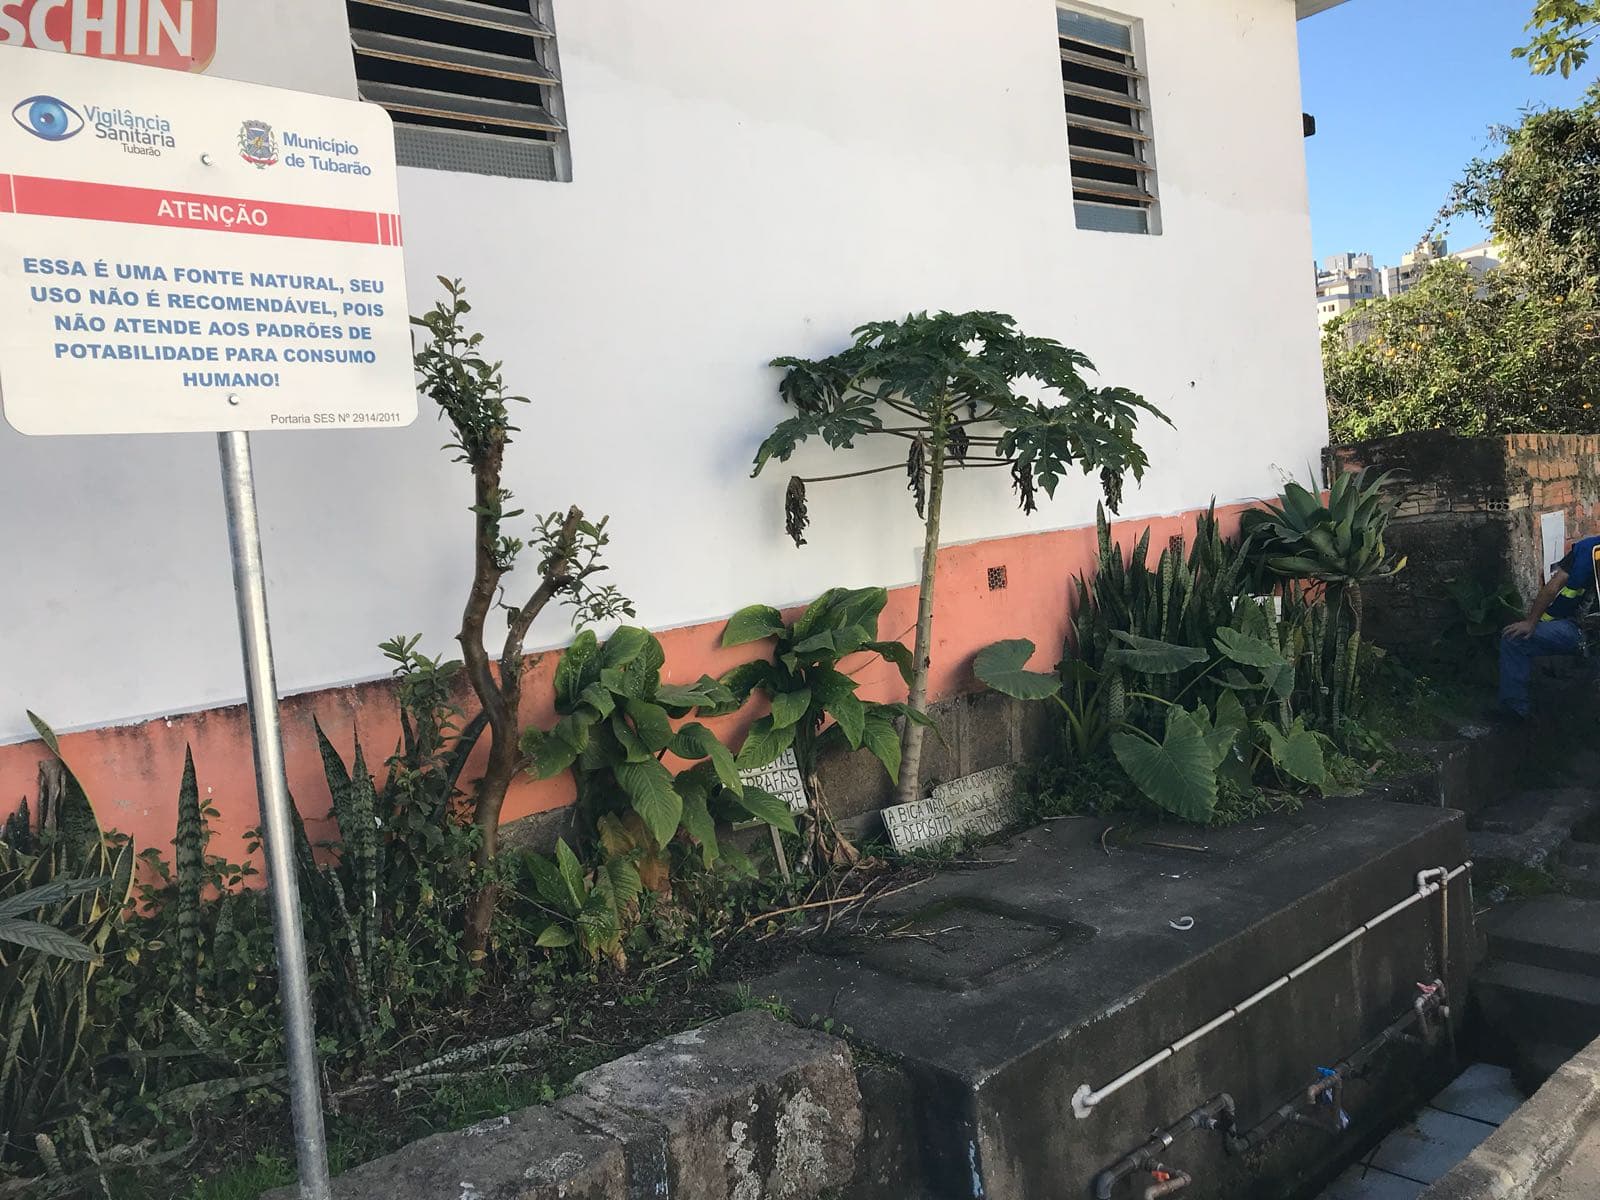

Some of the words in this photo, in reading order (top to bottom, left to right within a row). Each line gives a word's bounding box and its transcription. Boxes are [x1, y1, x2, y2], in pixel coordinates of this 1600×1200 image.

[83, 104, 171, 132] Vigilância
[95, 122, 175, 148] Sanitária
[283, 132, 359, 156] Município
[121, 143, 161, 157] Tubarão
[285, 153, 305, 168] de
[309, 155, 371, 176] Tubarão
[157, 198, 269, 228] ATENÇÃO
[23, 257, 87, 277] ESSA
[94, 259, 109, 278] É
[116, 263, 168, 282] UMA
[173, 267, 243, 286] FONTE
[250, 272, 344, 294] NATURAL,
[350, 278, 384, 293] SEU
[30, 286, 82, 304] USO
[89, 287, 139, 306] NÃO
[147, 289, 160, 307] É
[167, 293, 337, 317] RECOMENDÁVEL,
[343, 302, 384, 317] POIS
[54, 312, 106, 332] NÃO
[114, 317, 202, 336] ATENDE
[208, 321, 250, 337] AOS
[256, 322, 343, 339] PADRÕES
[349, 326, 372, 340] DE
[54, 343, 219, 361] POTABILIDADE
[225, 347, 278, 362] PARA
[283, 348, 376, 364] CONSUMO
[183, 372, 280, 388] HUMANO!
[270, 413, 311, 424] Portaria
[313, 413, 335, 424] SES
[338, 413, 350, 423] Nº
[352, 412, 401, 423] 2914/2011
[888, 811, 896, 825] A
[897, 804, 925, 823] BICA
